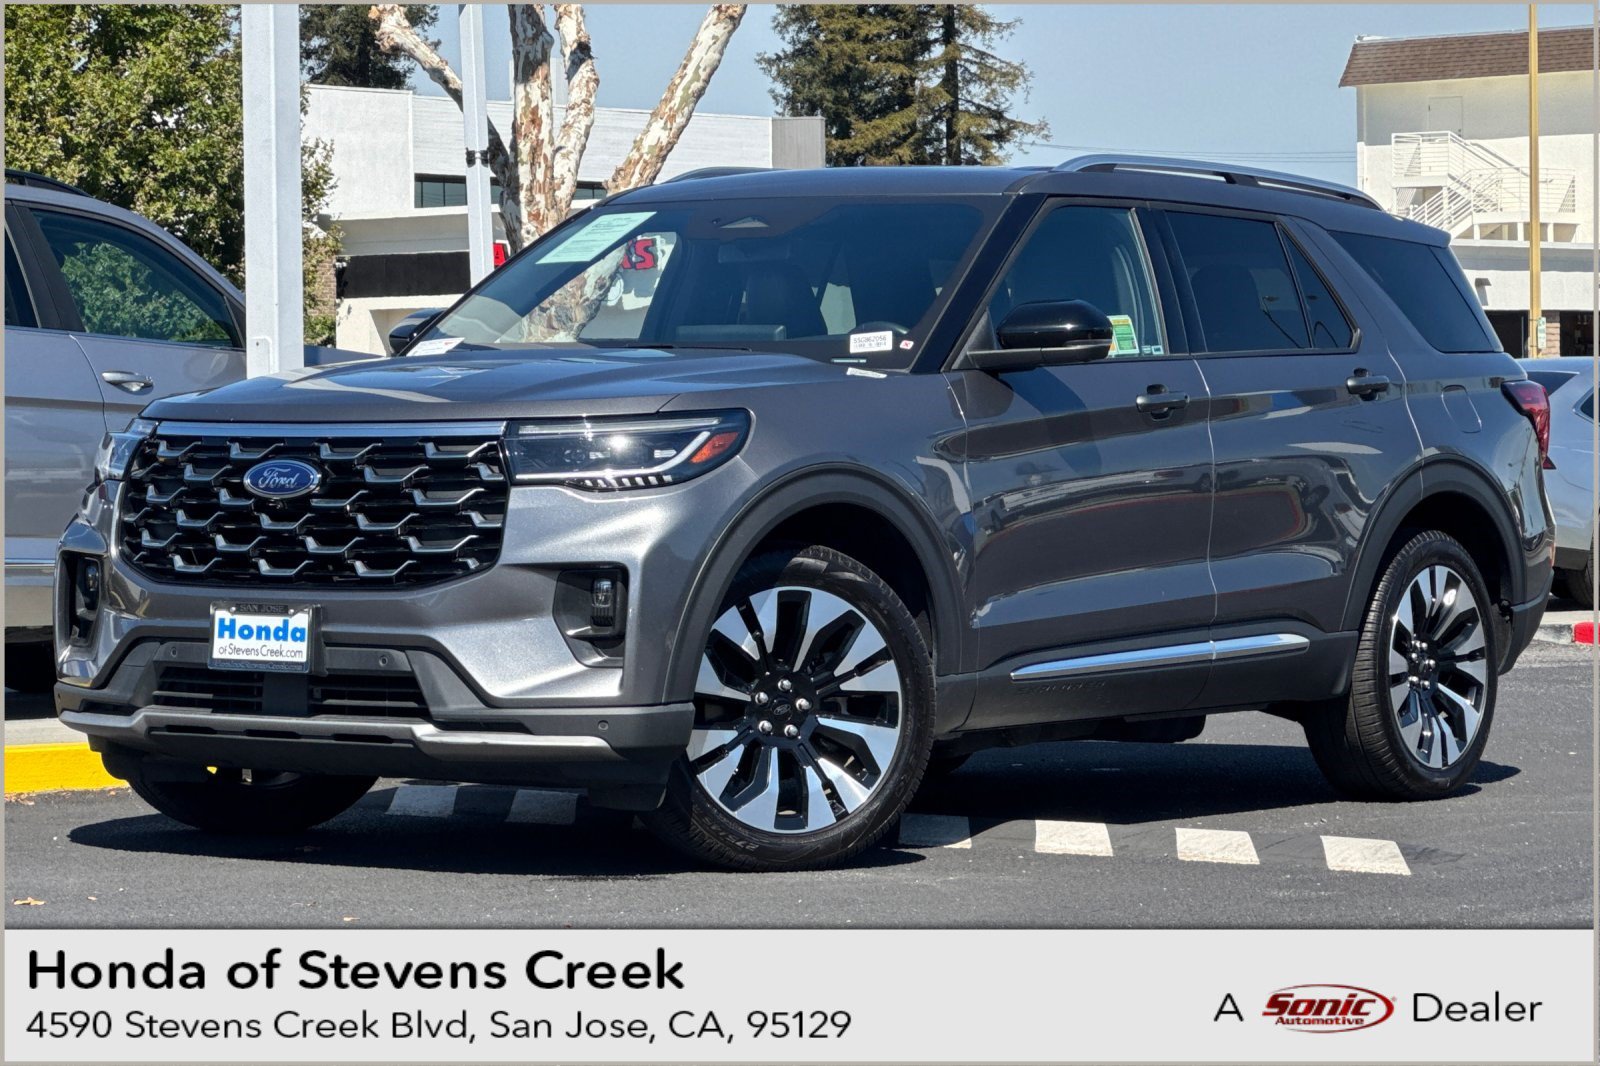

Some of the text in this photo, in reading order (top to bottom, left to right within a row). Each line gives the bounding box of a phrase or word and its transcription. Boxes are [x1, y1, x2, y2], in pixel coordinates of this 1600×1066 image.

[258, 467, 300, 489] Ford
[218, 617, 306, 642] Honda
[219, 644, 228, 655] of
